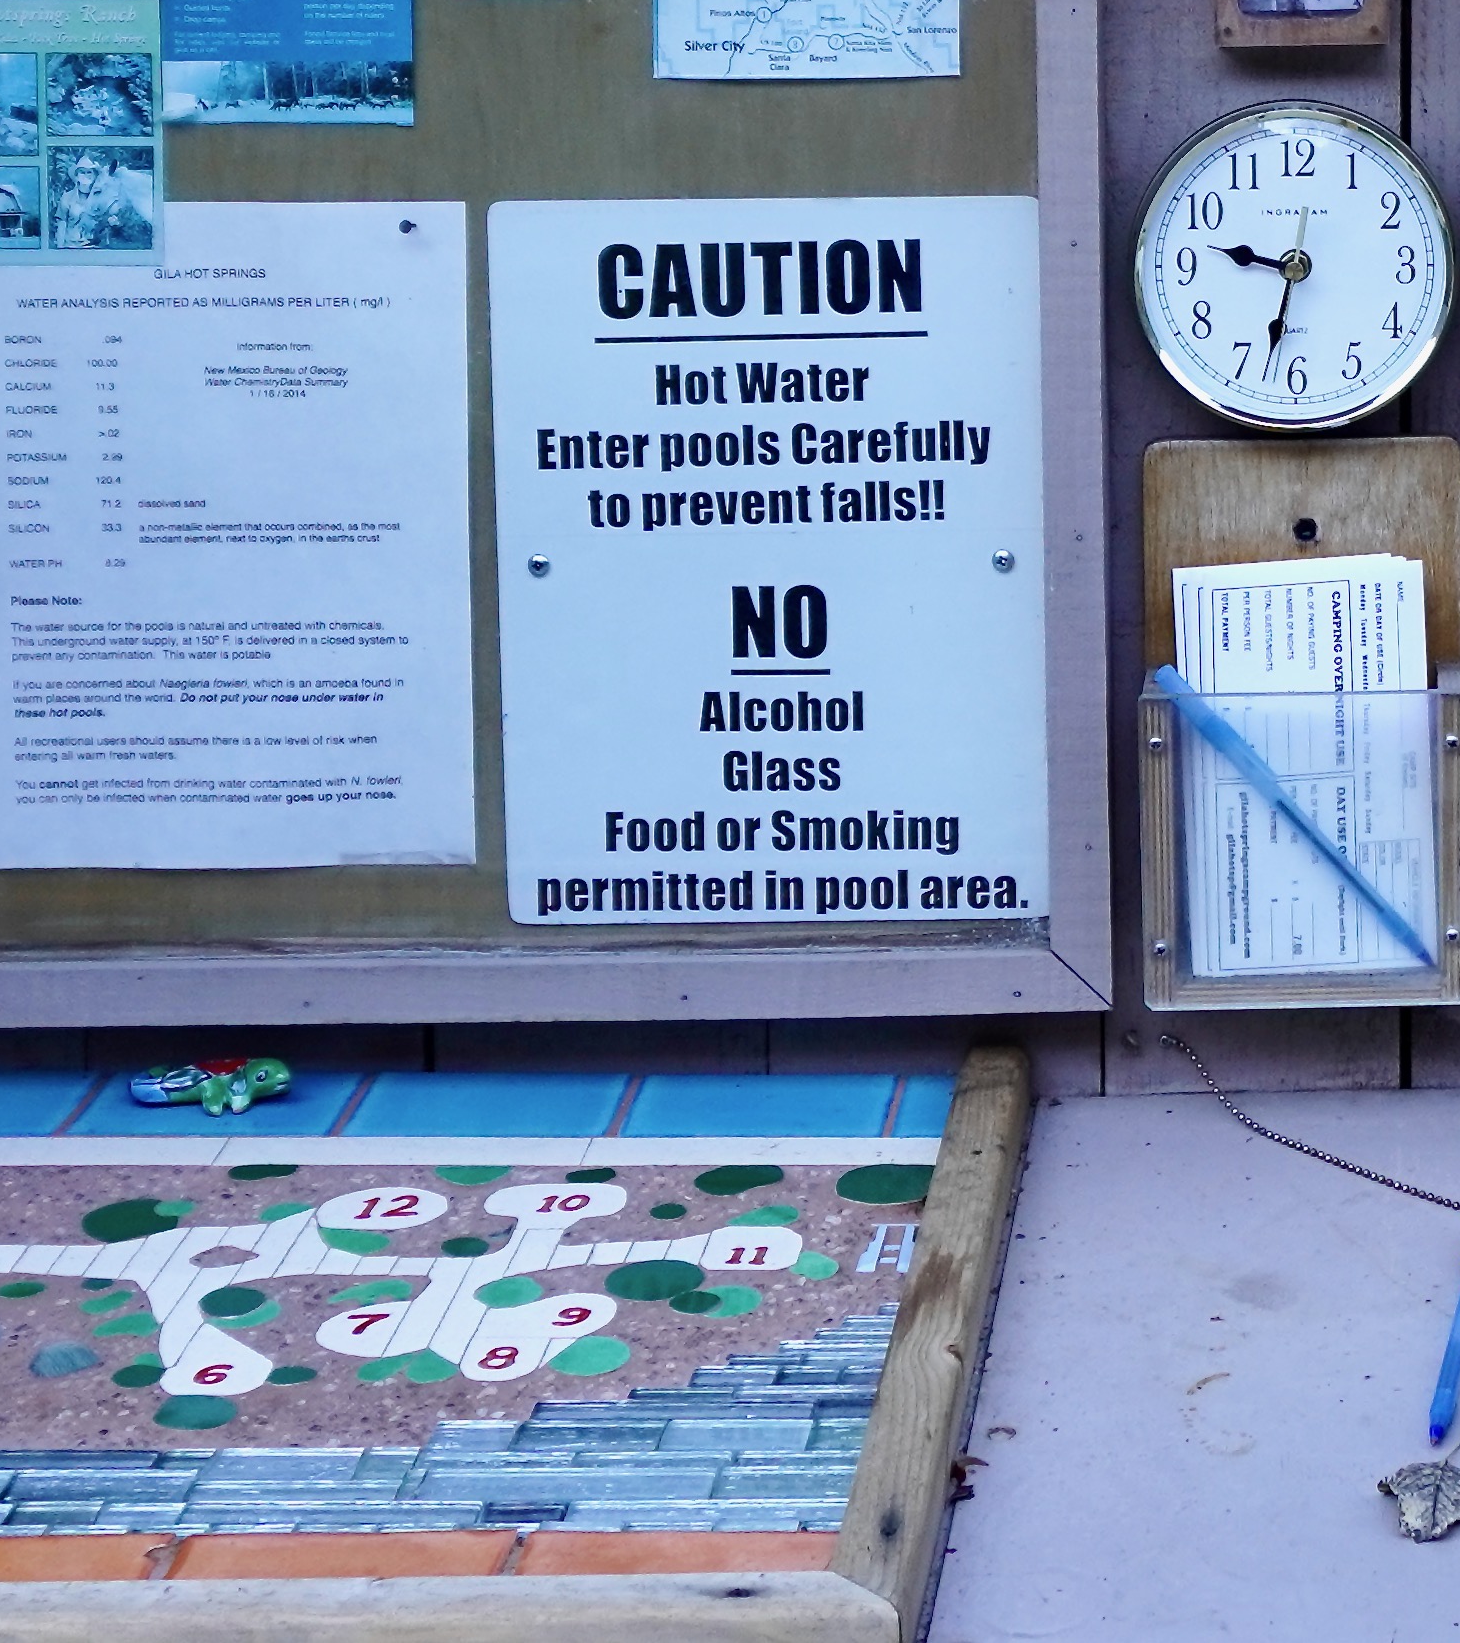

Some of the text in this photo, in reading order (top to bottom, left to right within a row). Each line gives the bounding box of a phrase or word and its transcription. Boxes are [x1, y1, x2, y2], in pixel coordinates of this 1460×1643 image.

[683, 40, 746, 55] Silver City
[1227, 152, 1261, 190] 11
[1280, 138, 1316, 178] 12
[1345, 152, 1359, 190] 1
[1186, 191, 1225, 231] 10
[1379, 191, 1402, 230] 2
[153, 267, 266, 280] GILA HOT SPRINGS
[596, 237, 923, 321] CAUTION
[1176, 246, 1198, 287] 9
[1395, 245, 1416, 285] 3
[1190, 300, 1213, 340] 8
[1381, 301, 1403, 340] 4
[1231, 341, 1253, 380] 7
[1286, 355, 1308, 396] 6
[1341, 341, 1363, 380] 5
[654, 361, 871, 407] Hot Water
[535, 418, 992, 473] Enter pools Carefully
[586, 478, 946, 533] to prevent falls!!
[730, 583, 829, 660] NO
[1331, 590, 1343, 654] CAMPING
[698, 689, 865, 733] Alcohol
[722, 749, 842, 793] Glass
[604, 808, 961, 857] Food or Smoking
[536, 868, 1030, 918] permitted in pool area.
[353, 1194, 422, 1221] 12
[535, 1193, 592, 1216] 10
[724, 1245, 770, 1267] 11
[344, 1312, 385, 1336] 7
[550, 1305, 594, 1330] 9
[193, 1363, 235, 1387] 6
[478, 1345, 519, 1372] 8
